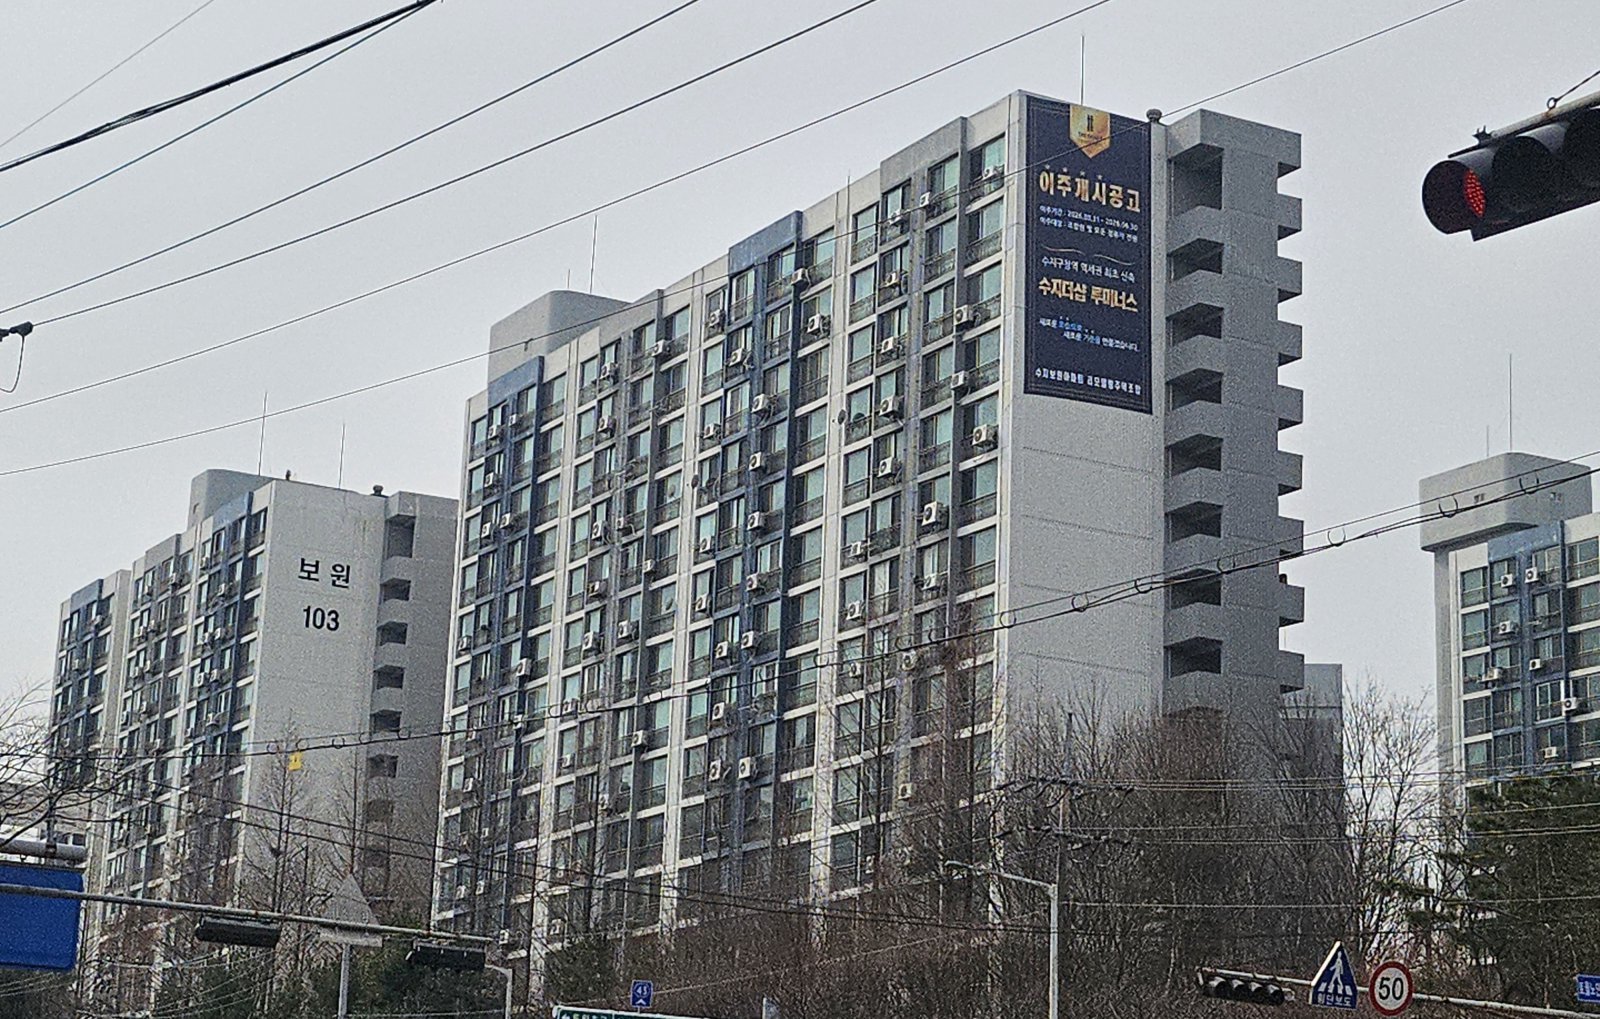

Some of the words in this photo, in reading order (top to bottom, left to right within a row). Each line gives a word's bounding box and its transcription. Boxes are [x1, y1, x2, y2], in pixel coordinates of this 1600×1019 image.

[1039, 170, 1141, 213] 이주개시공고
[1041, 255, 1078, 272] 수지구청역
[1080, 261, 1102, 276] 역세권
[1104, 266, 1120, 279] 최초
[1120, 270, 1136, 284] 신축
[1038, 276, 1087, 303] 수지더샵
[1090, 285, 1139, 313] 루미너스
[1035, 366, 1084, 385] 수지보원아파트
[303, 605, 340, 631] 103
[1317, 993, 1352, 1007] 횡단보도
[1378, 977, 1405, 1001] 50
